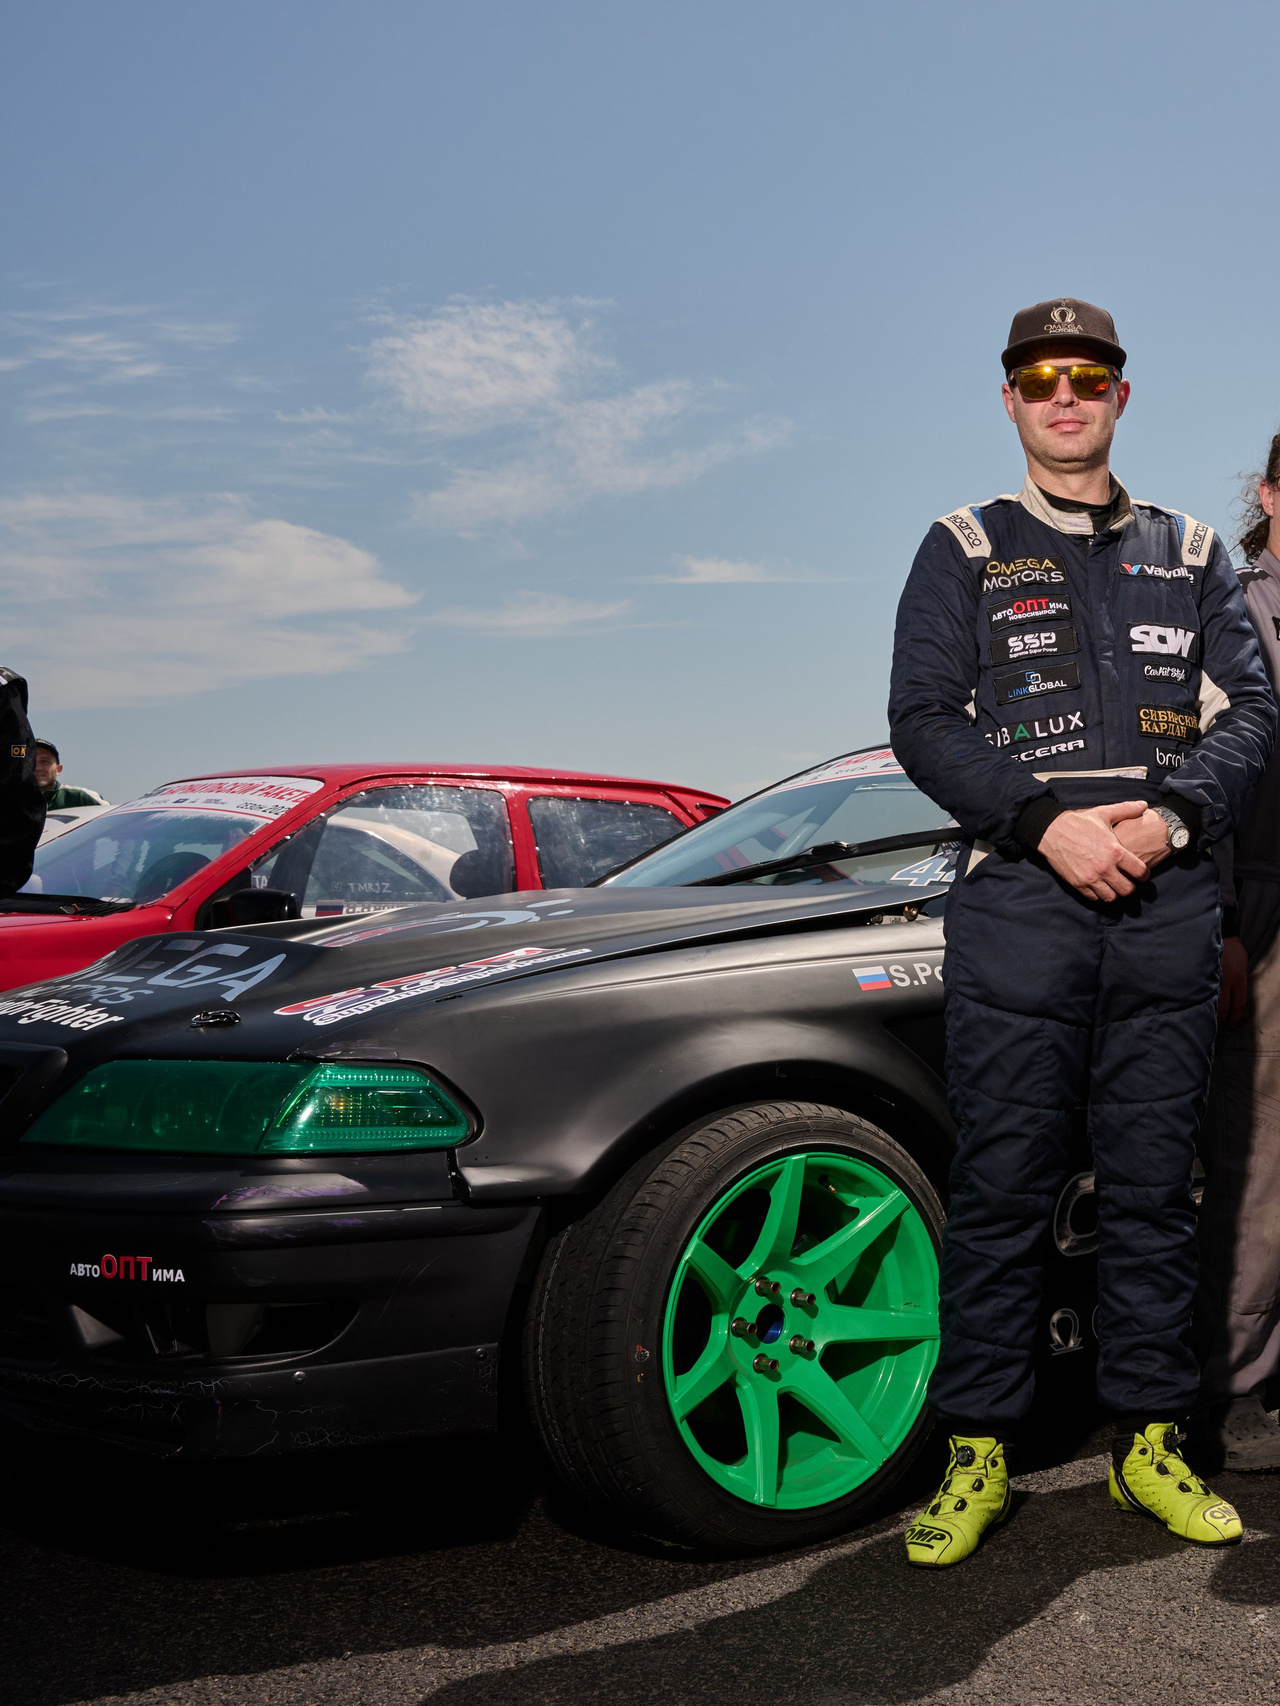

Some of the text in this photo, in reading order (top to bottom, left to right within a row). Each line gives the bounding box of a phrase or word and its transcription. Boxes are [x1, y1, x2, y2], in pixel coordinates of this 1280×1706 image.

[949, 513, 982, 547] sparco
[1188, 522, 1208, 557] sparco
[987, 558, 1056, 575] OMEGA
[983, 570, 1064, 592] MOTORS
[1009, 609, 1057, 621] НОВОСИБИРСК
[1008, 632, 1056, 653] SSP
[1130, 625, 1195, 658] SCW
[1009, 651, 1028, 659] Supreme
[1008, 680, 1067, 698] LINKGLOBAL
[1140, 708, 1198, 729] СИБИРСКИЙ
[1141, 721, 1187, 738] КАРДАН
[890, 851, 956, 887] 4
